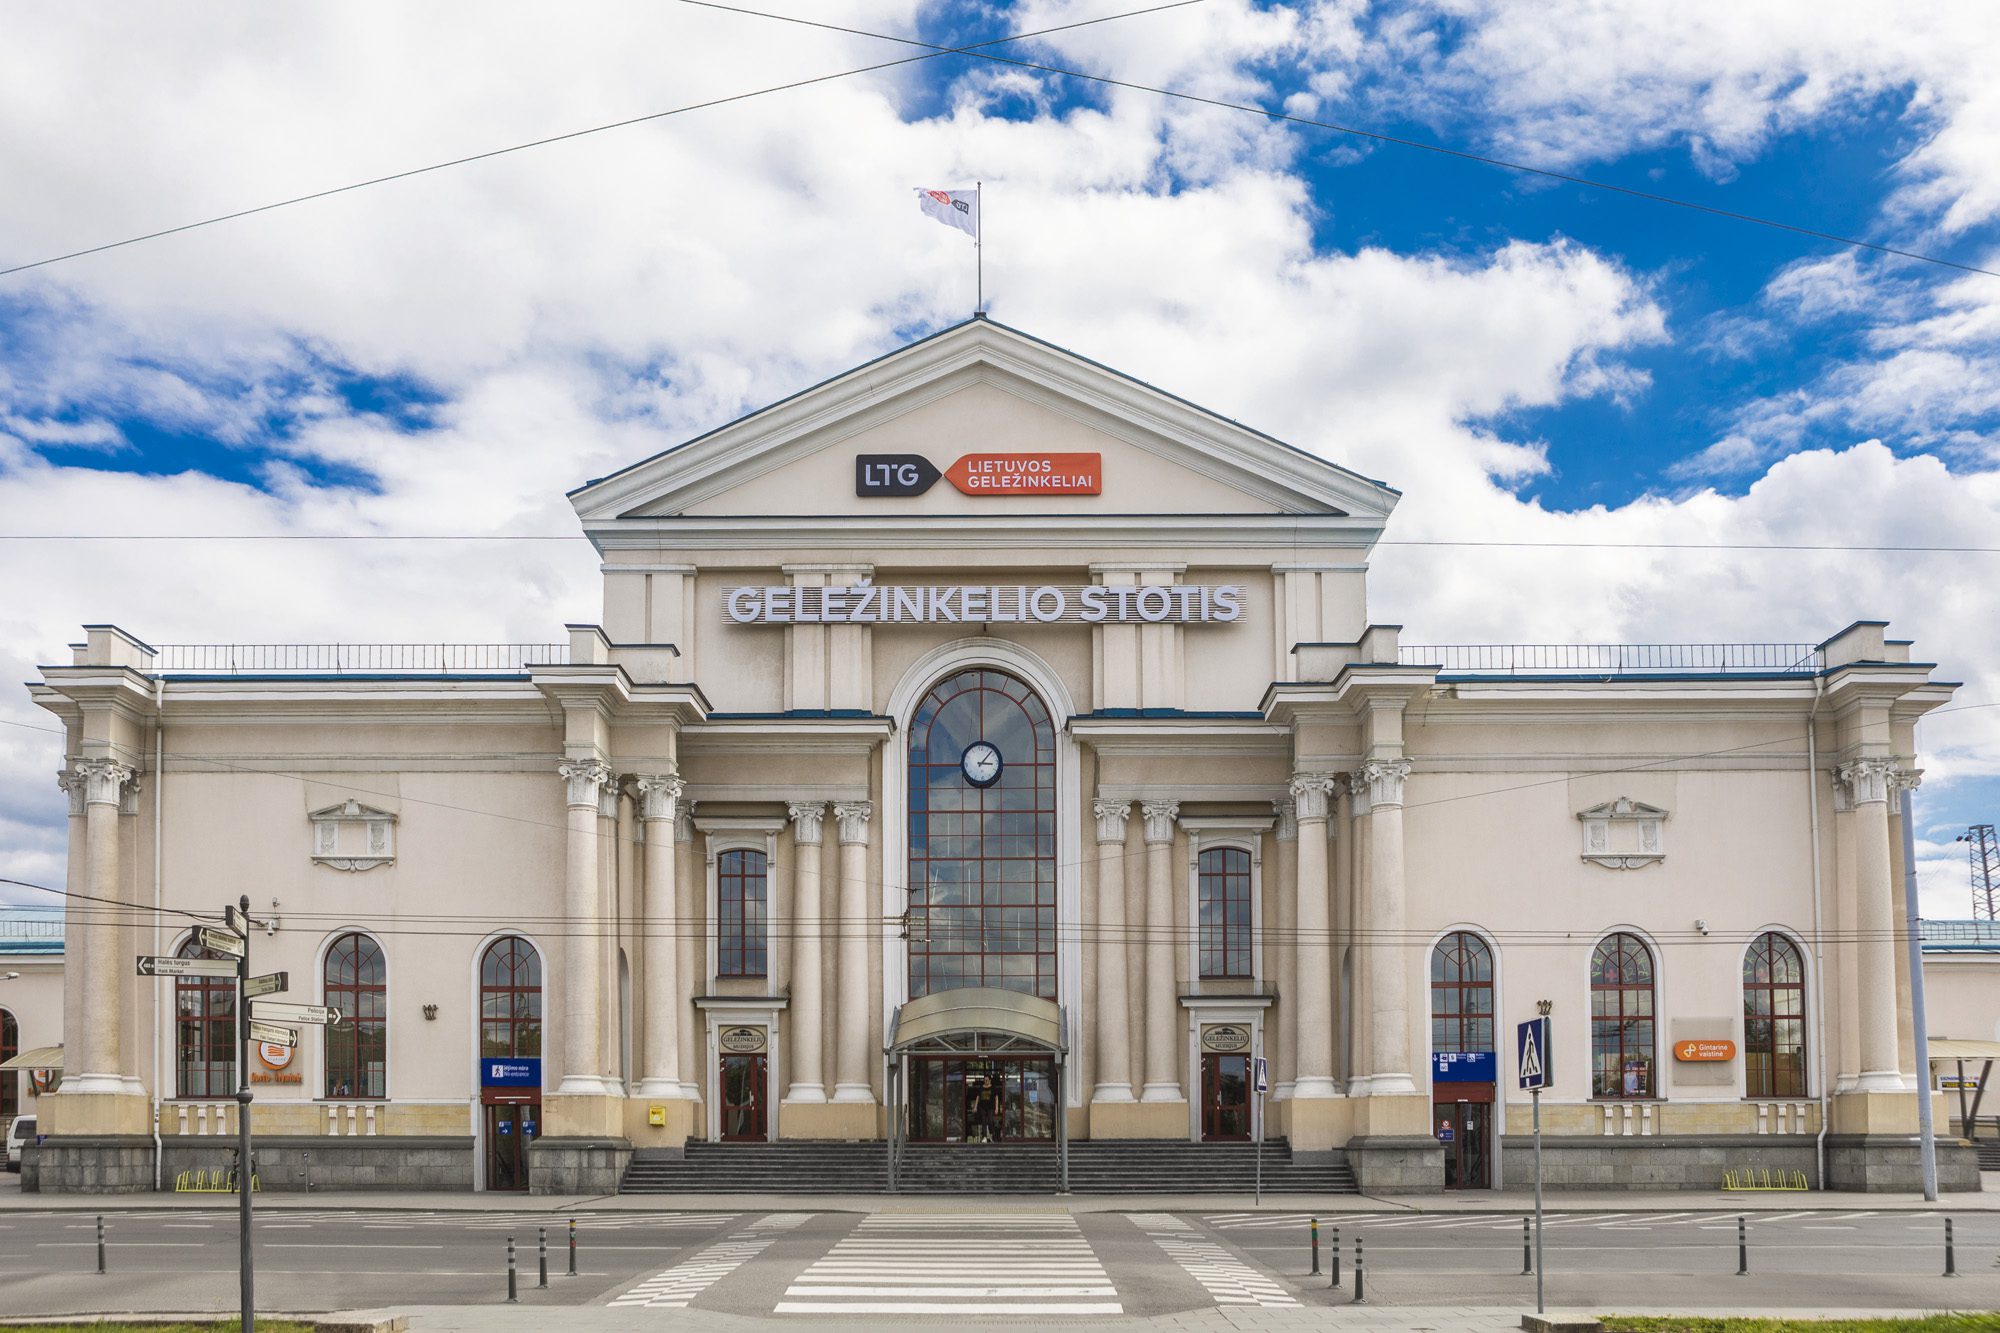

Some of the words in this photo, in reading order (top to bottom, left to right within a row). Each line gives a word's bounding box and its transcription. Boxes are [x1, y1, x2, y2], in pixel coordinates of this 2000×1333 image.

[865, 463, 919, 487] LTG
[967, 460, 1052, 473] LIETUVOS
[967, 473, 1093, 488] GELEŽINKELIAI
[728, 578, 1066, 623] GELEŽINKELIO
[1080, 585, 1241, 622] STOTIS
